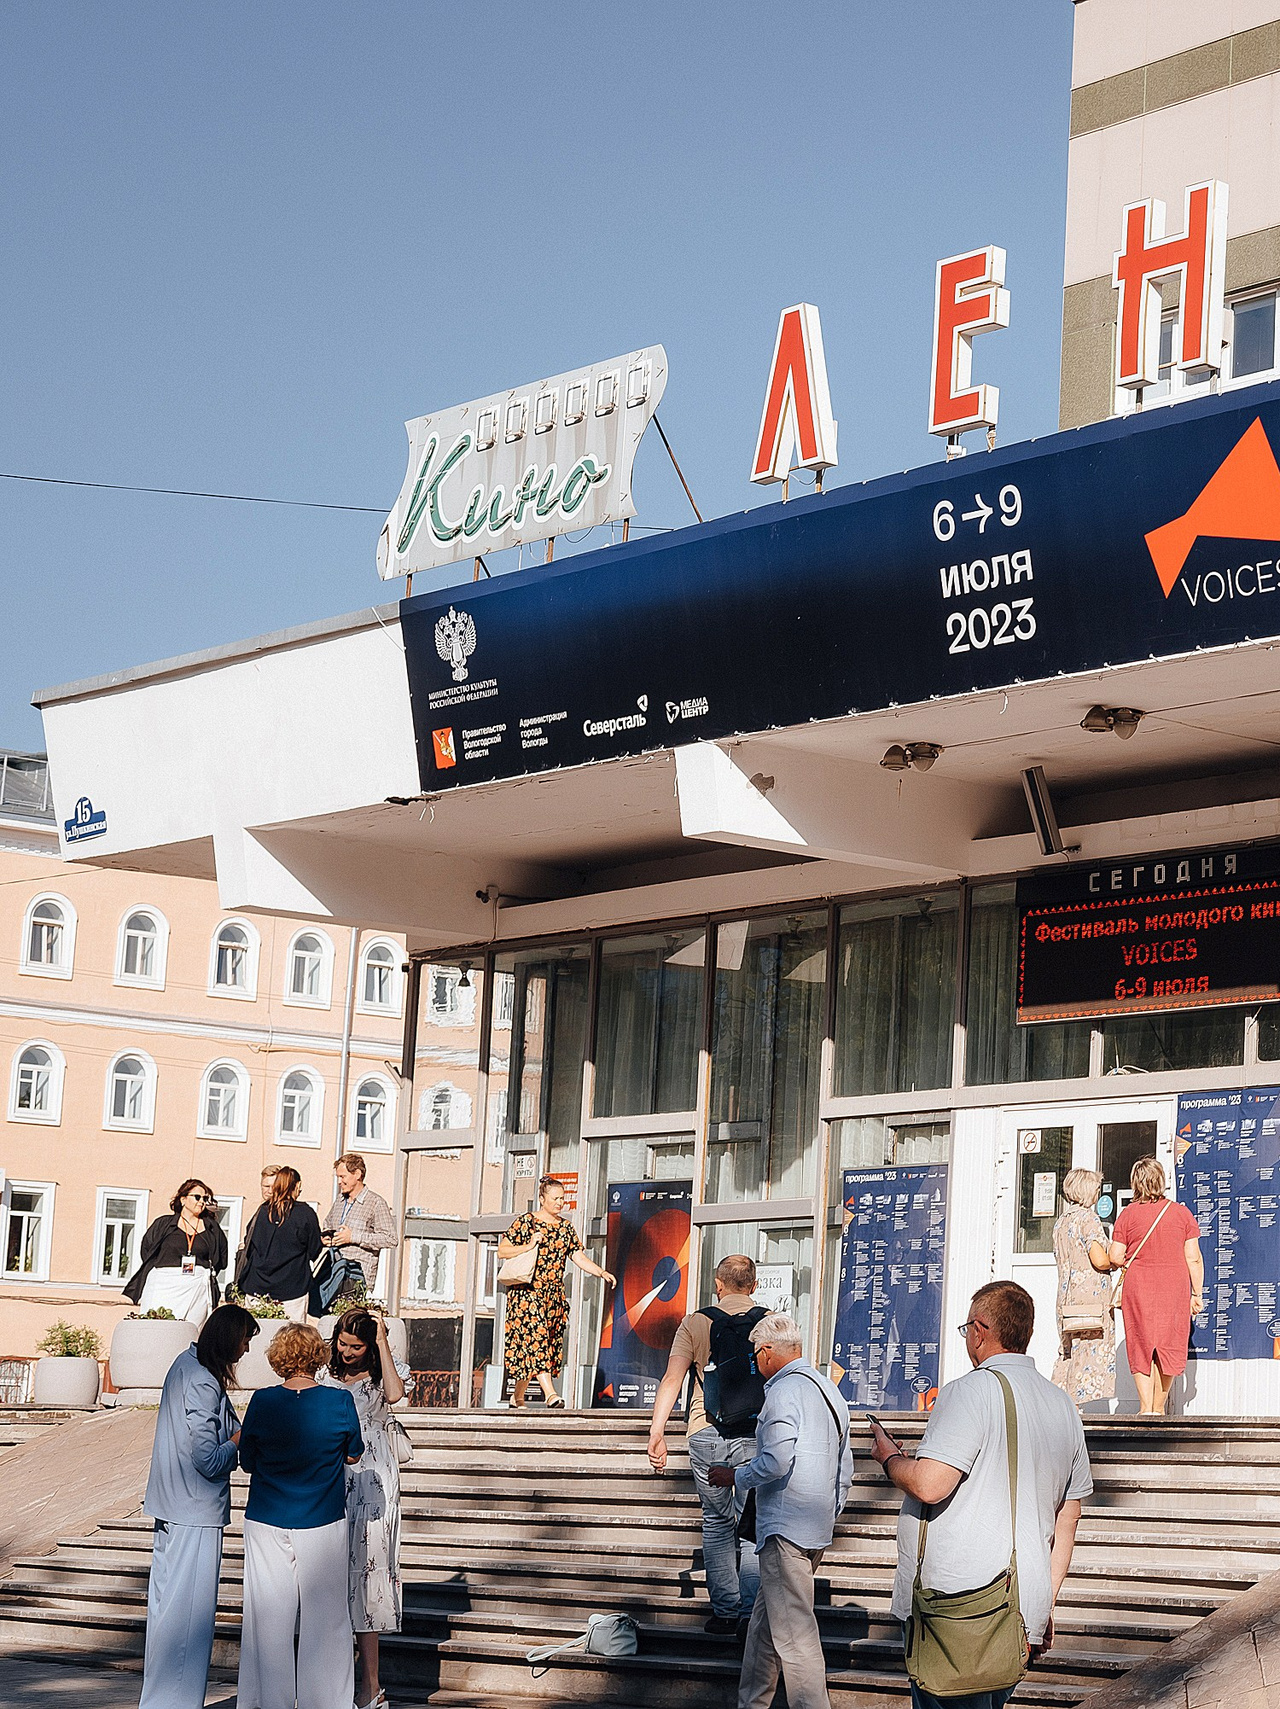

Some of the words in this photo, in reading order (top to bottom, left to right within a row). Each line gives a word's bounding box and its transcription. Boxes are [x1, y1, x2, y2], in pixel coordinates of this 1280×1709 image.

[394, 432, 610, 555] Кино
[940, 549, 1034, 599] июля
[946, 597, 1037, 655] 2023
[428, 684, 469, 701] МИНИСТЕРСТВО
[470, 678, 498, 693] КУЛЬТУРЫ
[429, 694, 465, 710] РОССИЙСКОЙ
[465, 688, 499, 704] ФЕДЕРАЦИИ
[680, 697, 708, 710] МЕДИА
[681, 706, 710, 720] ЦЕНТР
[519, 711, 568, 728] Администрация
[583, 713, 647, 738] Северсталь
[462, 722, 507, 740] Правительство
[463, 734, 502, 750] Вологодской
[520, 726, 543, 740] города
[464, 747, 490, 760] области
[521, 736, 549, 751] Вологды
[76, 799, 91, 824] 15
[1088, 854, 1238, 893] СЕГОДНЯ
[1034, 916, 1139, 944] Фестиваль
[1145, 904, 1245, 934] молодого
[1121, 938, 1198, 967] VOICES
[1114, 976, 1147, 1001] 6-9
[1152, 975, 1210, 998] июля
[1180, 1098, 1227, 1110] программа
[845, 1173, 884, 1184] программа
